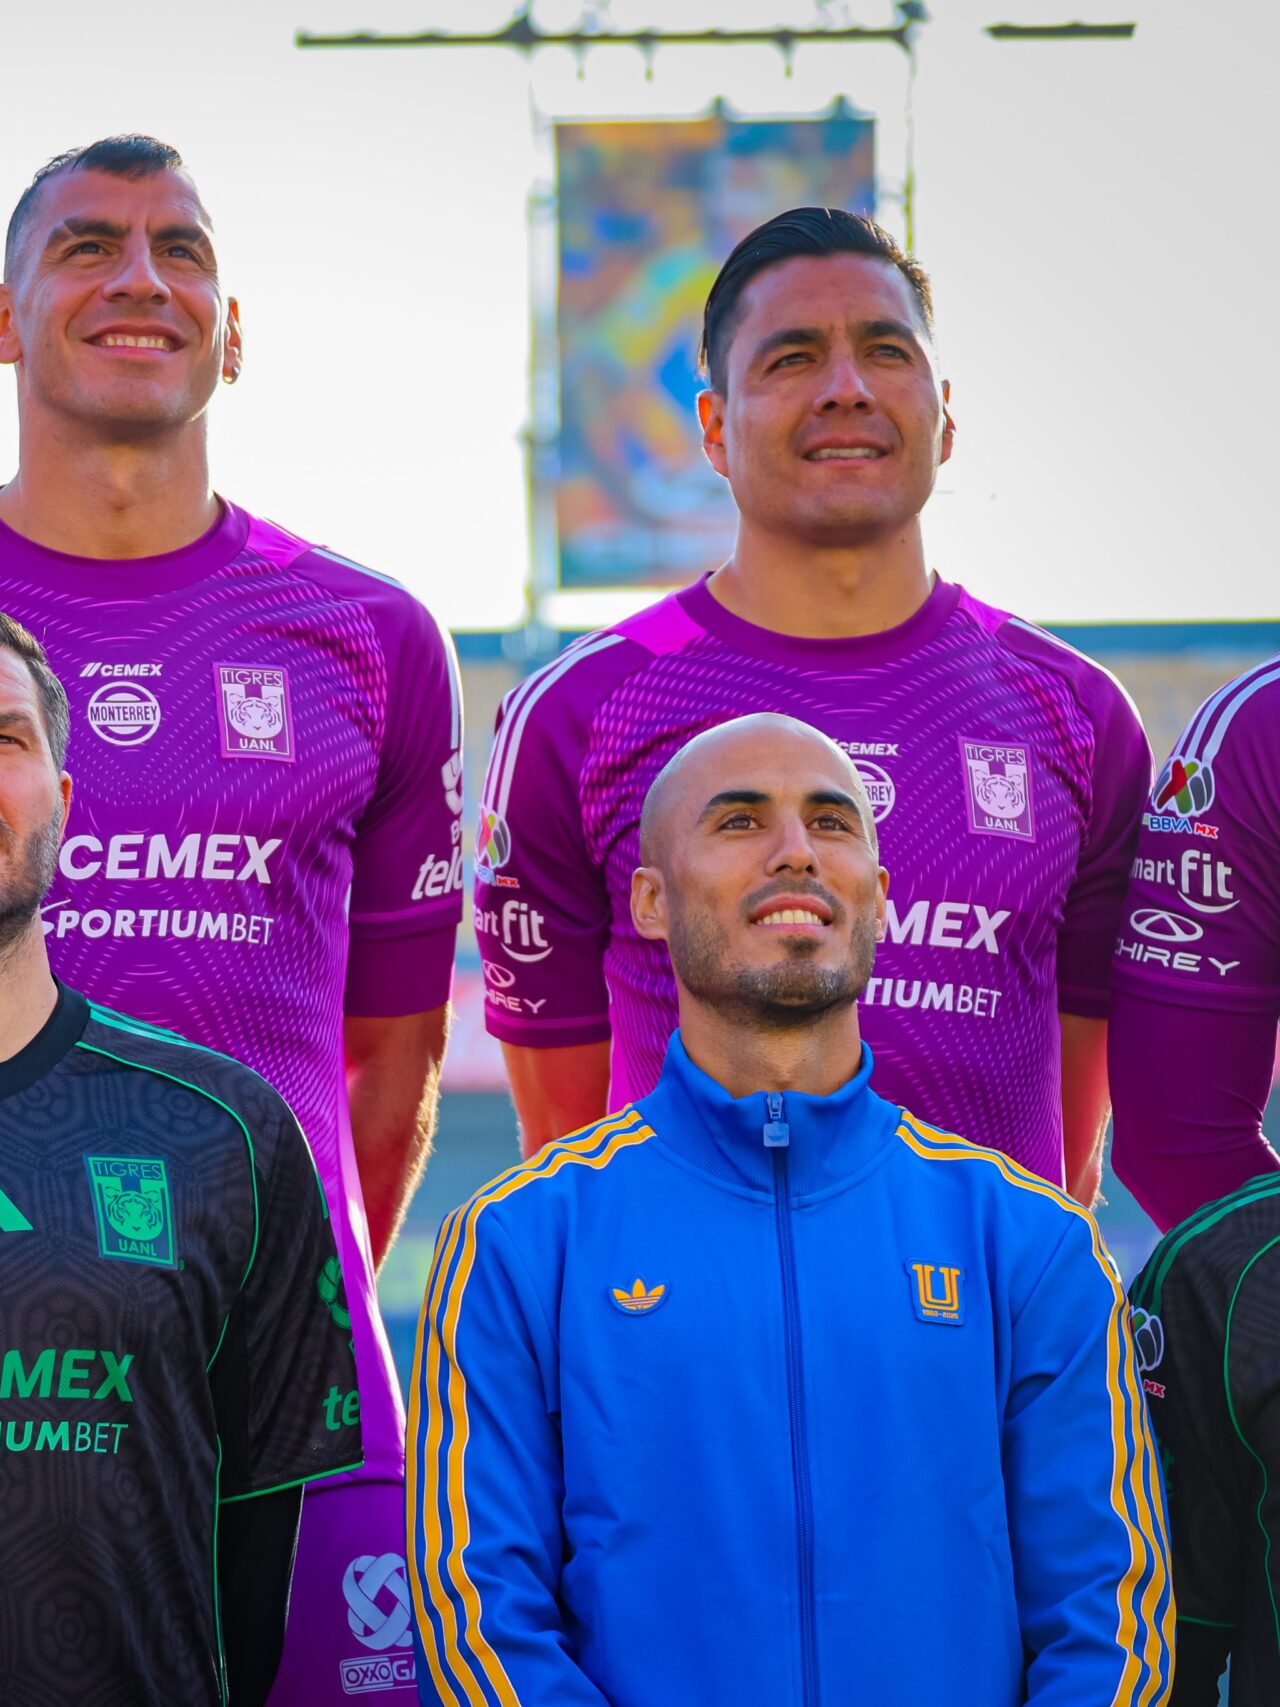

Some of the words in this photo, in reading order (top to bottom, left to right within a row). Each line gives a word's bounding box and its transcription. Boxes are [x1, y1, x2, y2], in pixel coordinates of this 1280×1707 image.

[101, 663, 163, 677] CEMEX
[221, 670, 283, 688] TIGRES
[90, 705, 159, 722] MONTERREY
[240, 738, 276, 751] UANL
[967, 746, 1025, 764] TIGRES
[984, 816, 1019, 832] UANL
[1149, 816, 1192, 835] BBVA
[1194, 823, 1219, 839] MX
[59, 833, 283, 884] CEMEX
[1181, 849, 1234, 899] fit
[503, 900, 548, 948] fit
[1115, 937, 1240, 976] HIREY
[94, 1162, 161, 1179] TIGRES
[119, 1239, 157, 1256] UANL
[912, 1264, 960, 1311] U
[1143, 1379, 1166, 1399] MX
